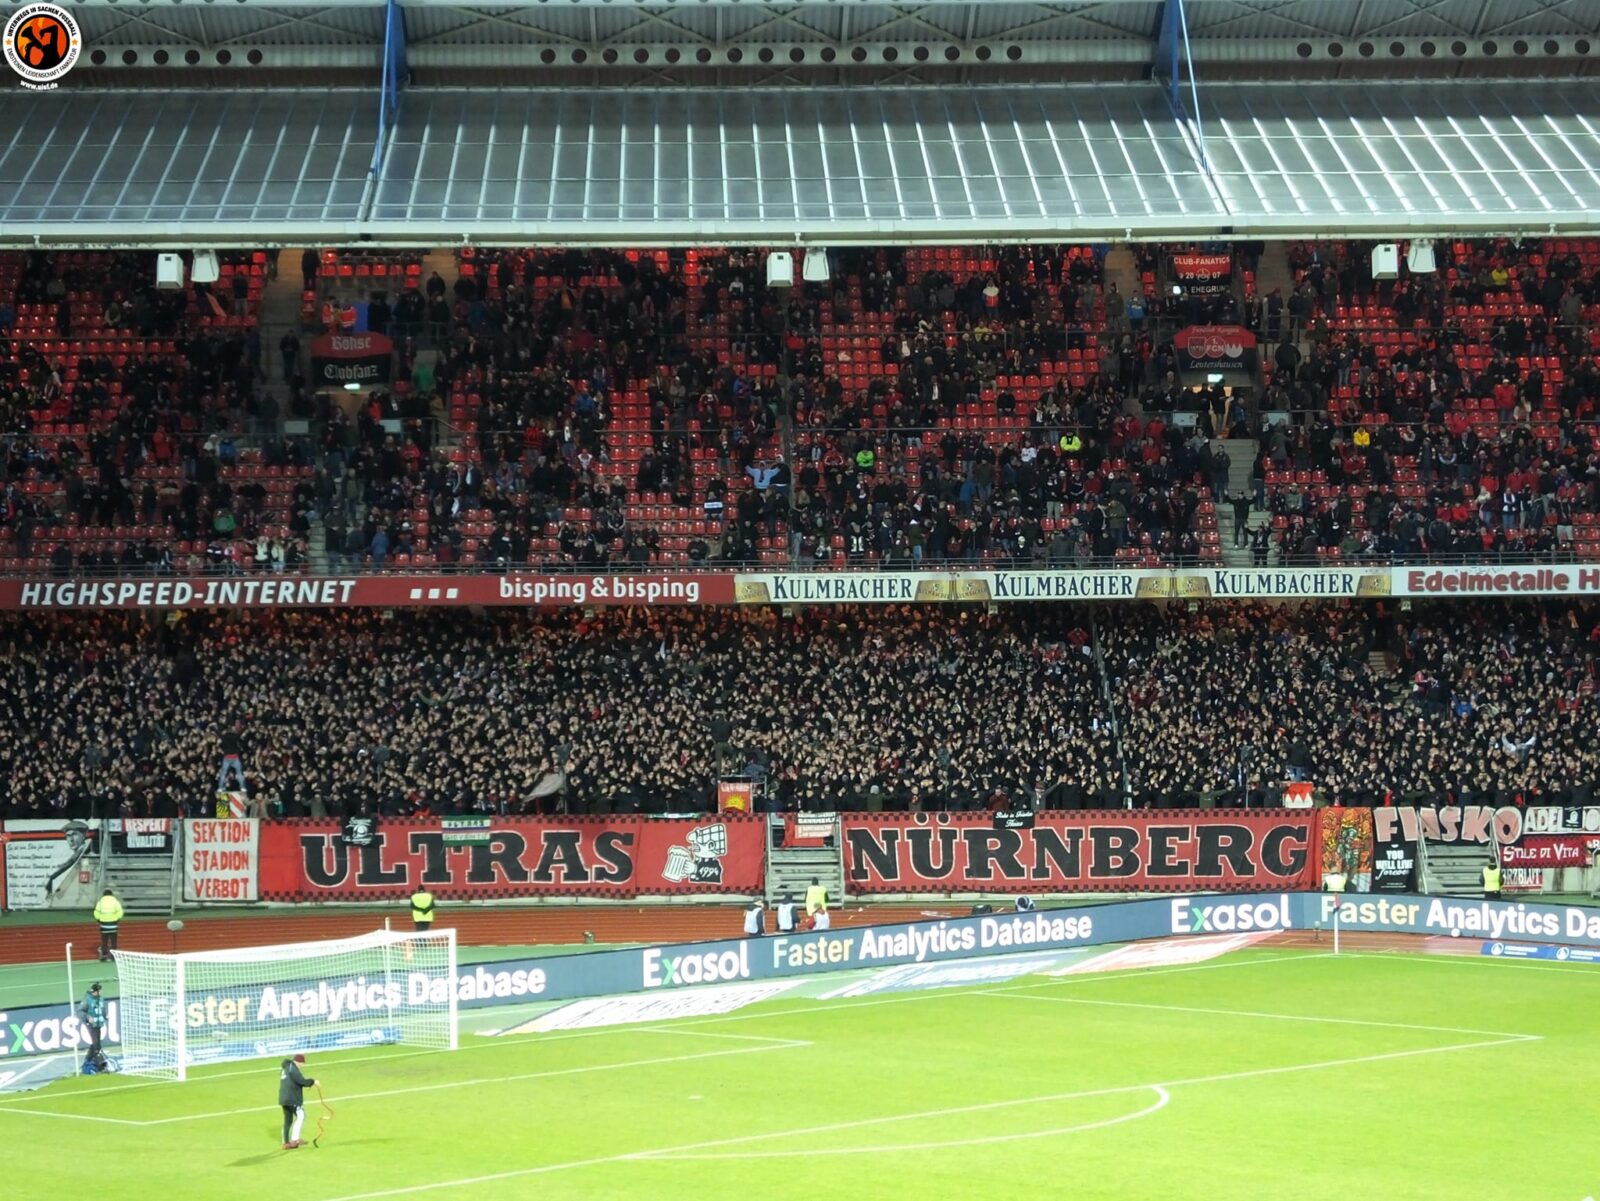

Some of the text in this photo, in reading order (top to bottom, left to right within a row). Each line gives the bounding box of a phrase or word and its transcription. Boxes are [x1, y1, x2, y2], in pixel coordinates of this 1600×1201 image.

[1173, 256, 1230, 265] CLUB-FANATICS
[20, 580, 356, 606] HIGHSPEED-INTERNET
[500, 576, 699, 602] bisping & bisping
[774, 576, 913, 599] KULMBACHER
[994, 573, 1133, 596] KULMBACHER
[1214, 570, 1354, 594] KULMBACHER
[1408, 569, 1569, 592] Edelmetalle
[193, 821, 250, 844] SEKTION
[1373, 806, 1522, 844] FIASKO
[846, 811, 1308, 880] NÜRNBERG
[1386, 850, 1404, 860] YOU
[193, 850, 249, 872] STADION
[300, 831, 636, 888] ULTRAS
[193, 877, 249, 899] VERBOT
[1171, 894, 1292, 933] Exasol
[1321, 895, 1420, 926] Faster
[1426, 899, 1559, 938] Analytics
[643, 914, 1093, 988] Exasol Faster Analytics Database
[257, 976, 401, 1022] Analytics
